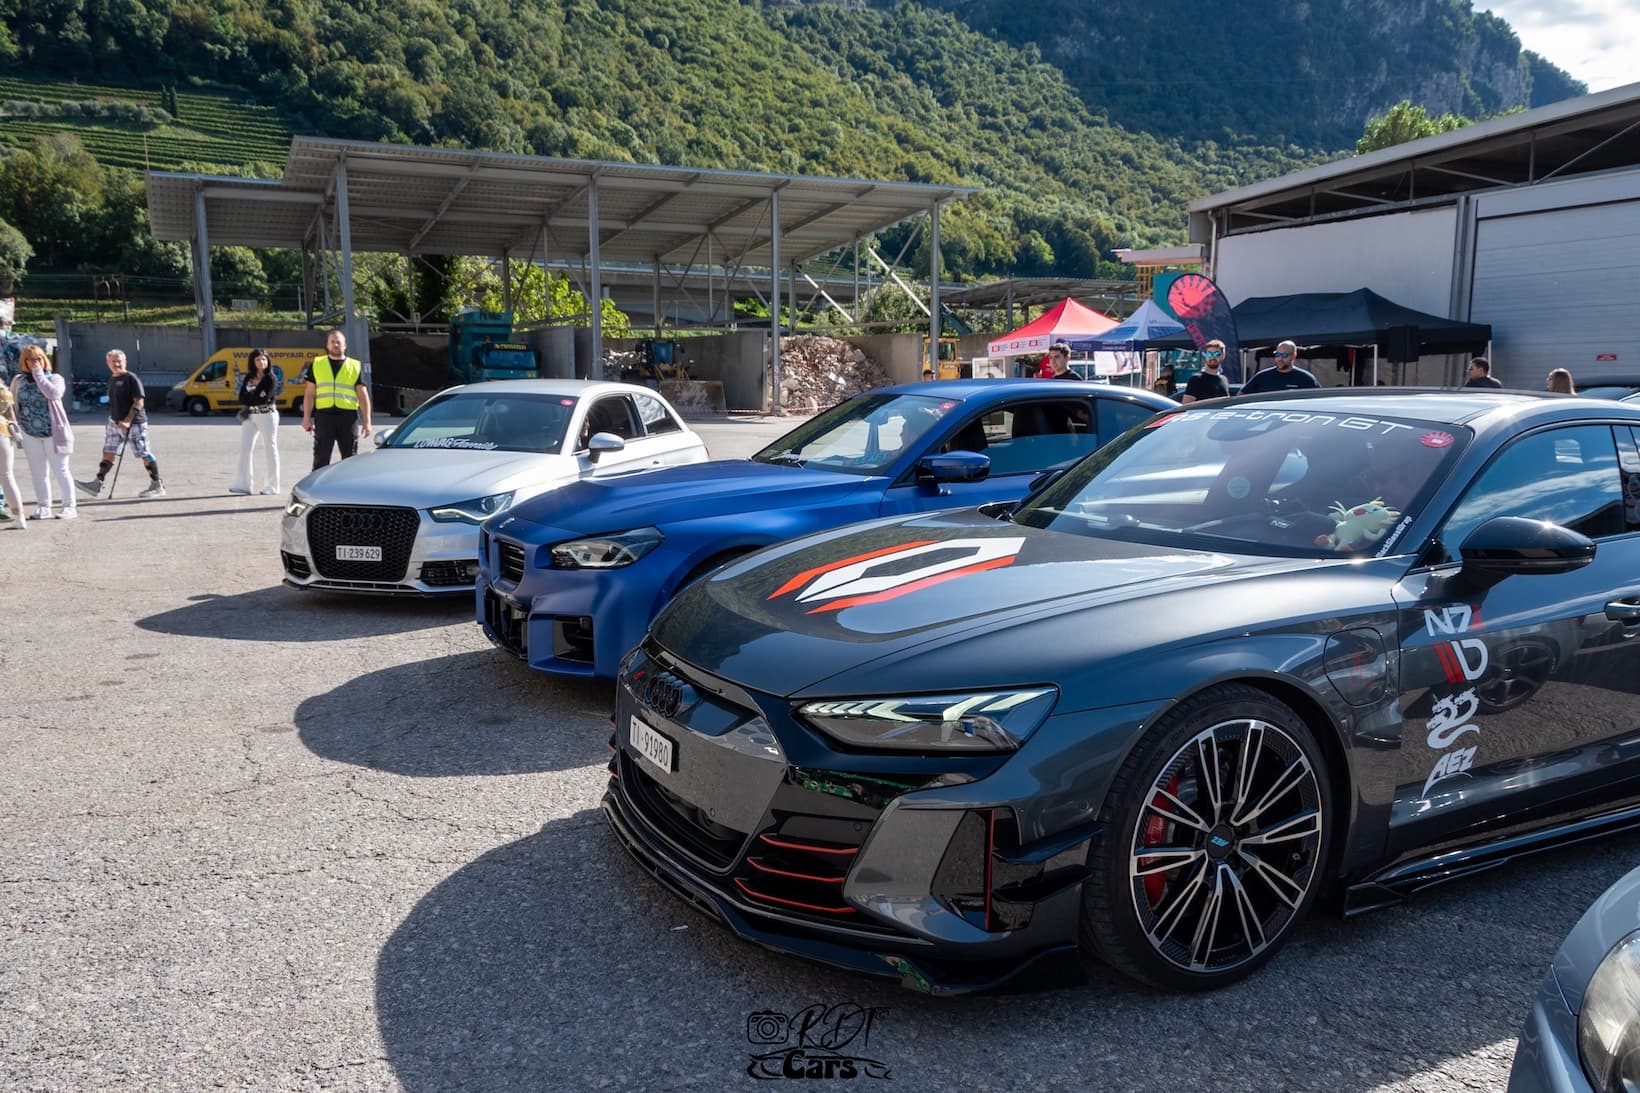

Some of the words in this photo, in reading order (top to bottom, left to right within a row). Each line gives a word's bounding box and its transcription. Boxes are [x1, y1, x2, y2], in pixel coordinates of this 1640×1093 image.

[1211, 411, 1337, 426] e-tron
[1337, 417, 1415, 435] GT
[1423, 604, 1473, 637] N7
